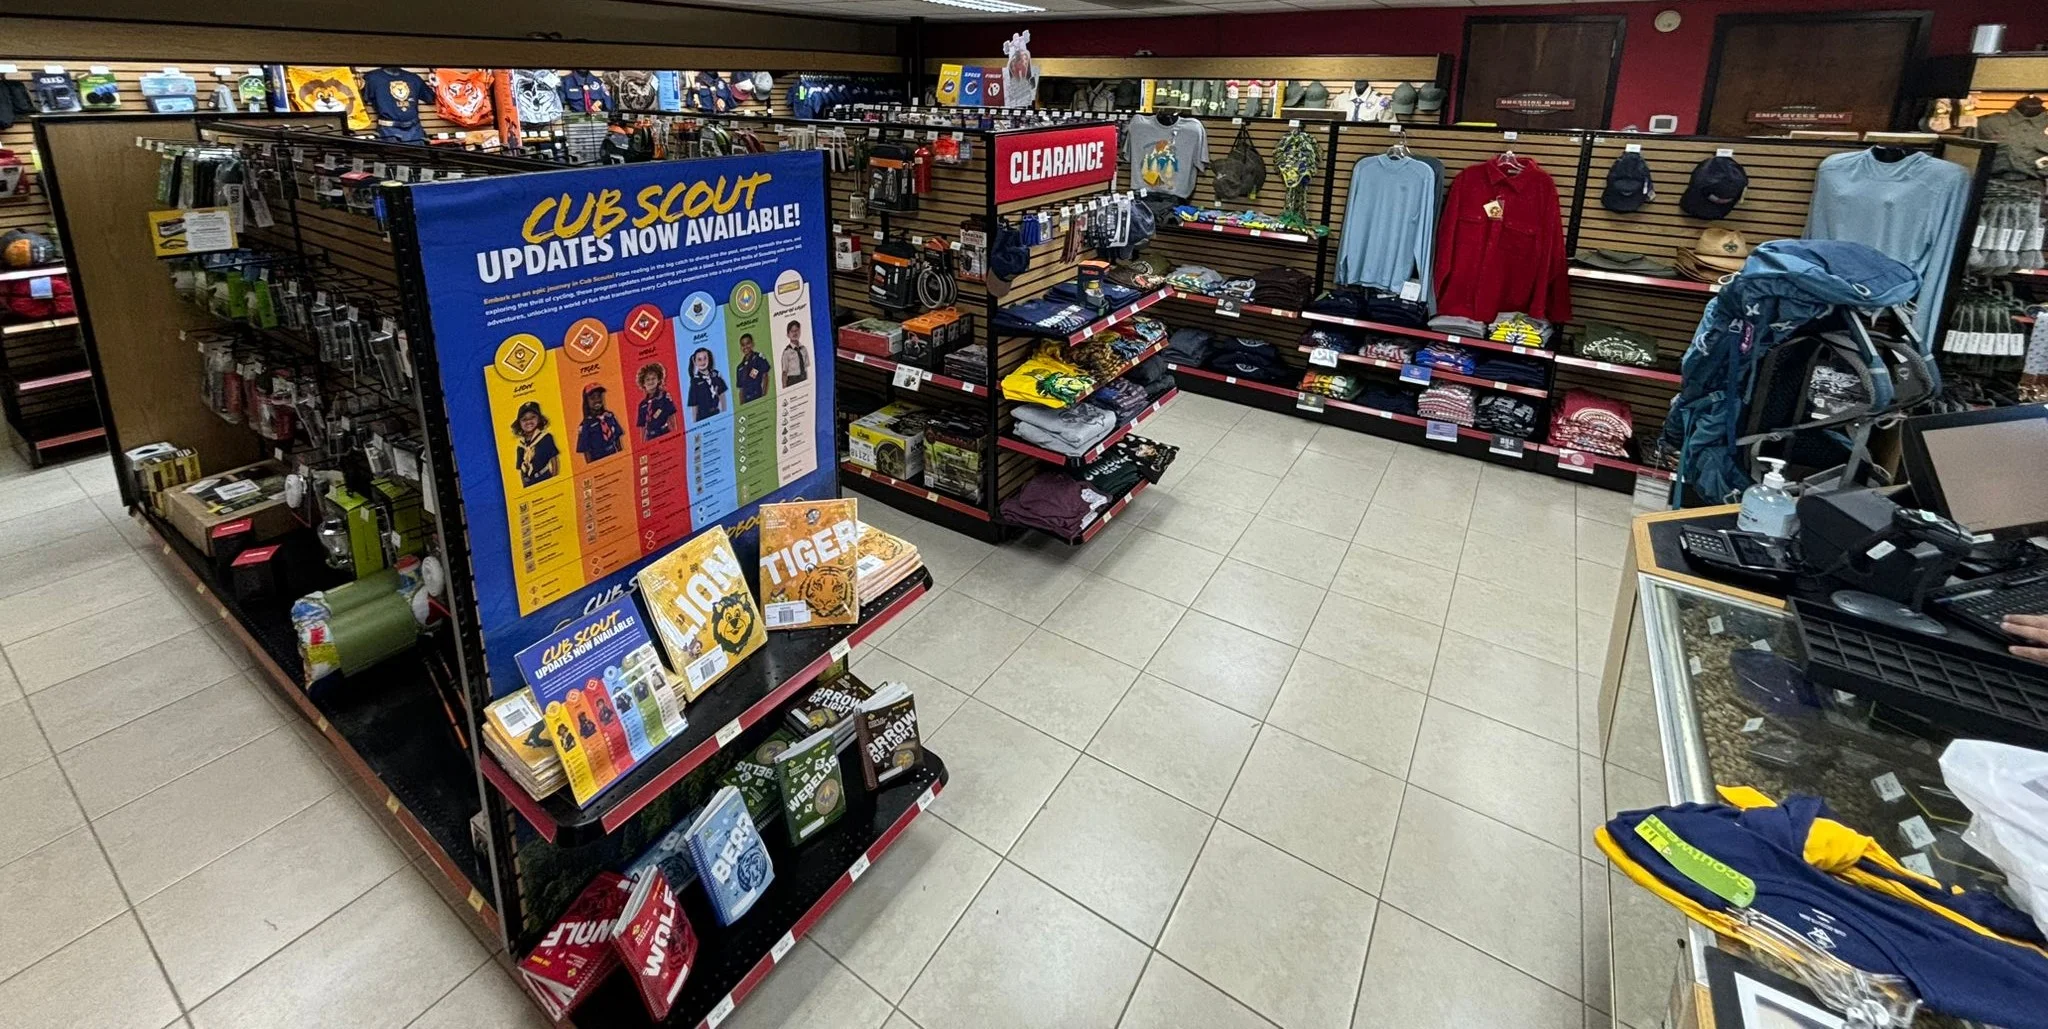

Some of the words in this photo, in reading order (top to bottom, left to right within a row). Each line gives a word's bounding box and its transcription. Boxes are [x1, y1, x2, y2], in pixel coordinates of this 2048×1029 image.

[1010, 141, 1104, 185] CLEARANCE
[522, 188, 628, 244] CUB
[631, 171, 772, 228] SCOUT
[477, 233, 614, 284] UPDATES
[620, 221, 679, 258] NOW
[686, 202, 801, 247] AVAILABLE!
[483, 294, 510, 305] Embark
[532, 287, 546, 296] epic
[547, 280, 571, 293] journey
[579, 277, 593, 285] Cub
[593, 273, 615, 283] Scouts!
[615, 270, 630, 278] From
[631, 266, 650, 275] reeling
[675, 257, 689, 266] catch
[695, 254, 710, 263] diving
[485, 304, 517, 316] exploring
[518, 301, 529, 309] the
[529, 297, 544, 307] thrill
[552, 292, 575, 303] cycling,
[576, 288, 593, 297] these
[593, 283, 618, 295] program
[618, 278, 640, 289] updates
[640, 274, 655, 283] make
[655, 271, 675, 281] earning
[675, 268, 687, 276] your
[687, 265, 698, 273] rank
[716, 258, 733, 267] Explore
[741, 253, 754, 261] thrills
[758, 249, 777, 259] Scouting
[487, 314, 526, 327] adventures,
[527, 306, 558, 318] unlocking
[564, 300, 581, 310] world
[588, 296, 599, 304] fun
[599, 293, 611, 302] that
[611, 287, 641, 299] transforms
[641, 283, 656, 293] every
[656, 280, 667, 288] Cub
[667, 277, 683, 287] Scout
[682, 272, 709, 283] experience
[722, 267, 733, 275] truly
[732, 261, 762, 272] unforgettable
[514, 382, 534, 393] LION
[580, 363, 600, 374] TIGER
[760, 519, 858, 585] TIGER
[583, 584, 622, 615] CUB
[660, 545, 743, 651] LION
[535, 653, 574, 680] UPDATES
[573, 638, 594, 662] NOW
[593, 615, 636, 649] AVAILABLE!
[542, 637, 573, 665] CUB
[574, 609, 621, 647] SCOUT
[809, 694, 824, 707] OF
[821, 698, 851, 718] LIGHT
[813, 687, 866, 711] ARROW
[865, 710, 918, 756] ARROW
[872, 750, 887, 764] OF
[886, 729, 915, 753] LIGHT
[787, 754, 838, 812] WEBELOS
[711, 811, 751, 886] BEAR
[540, 918, 618, 947] WOLF
[644, 884, 676, 977] WOLF
